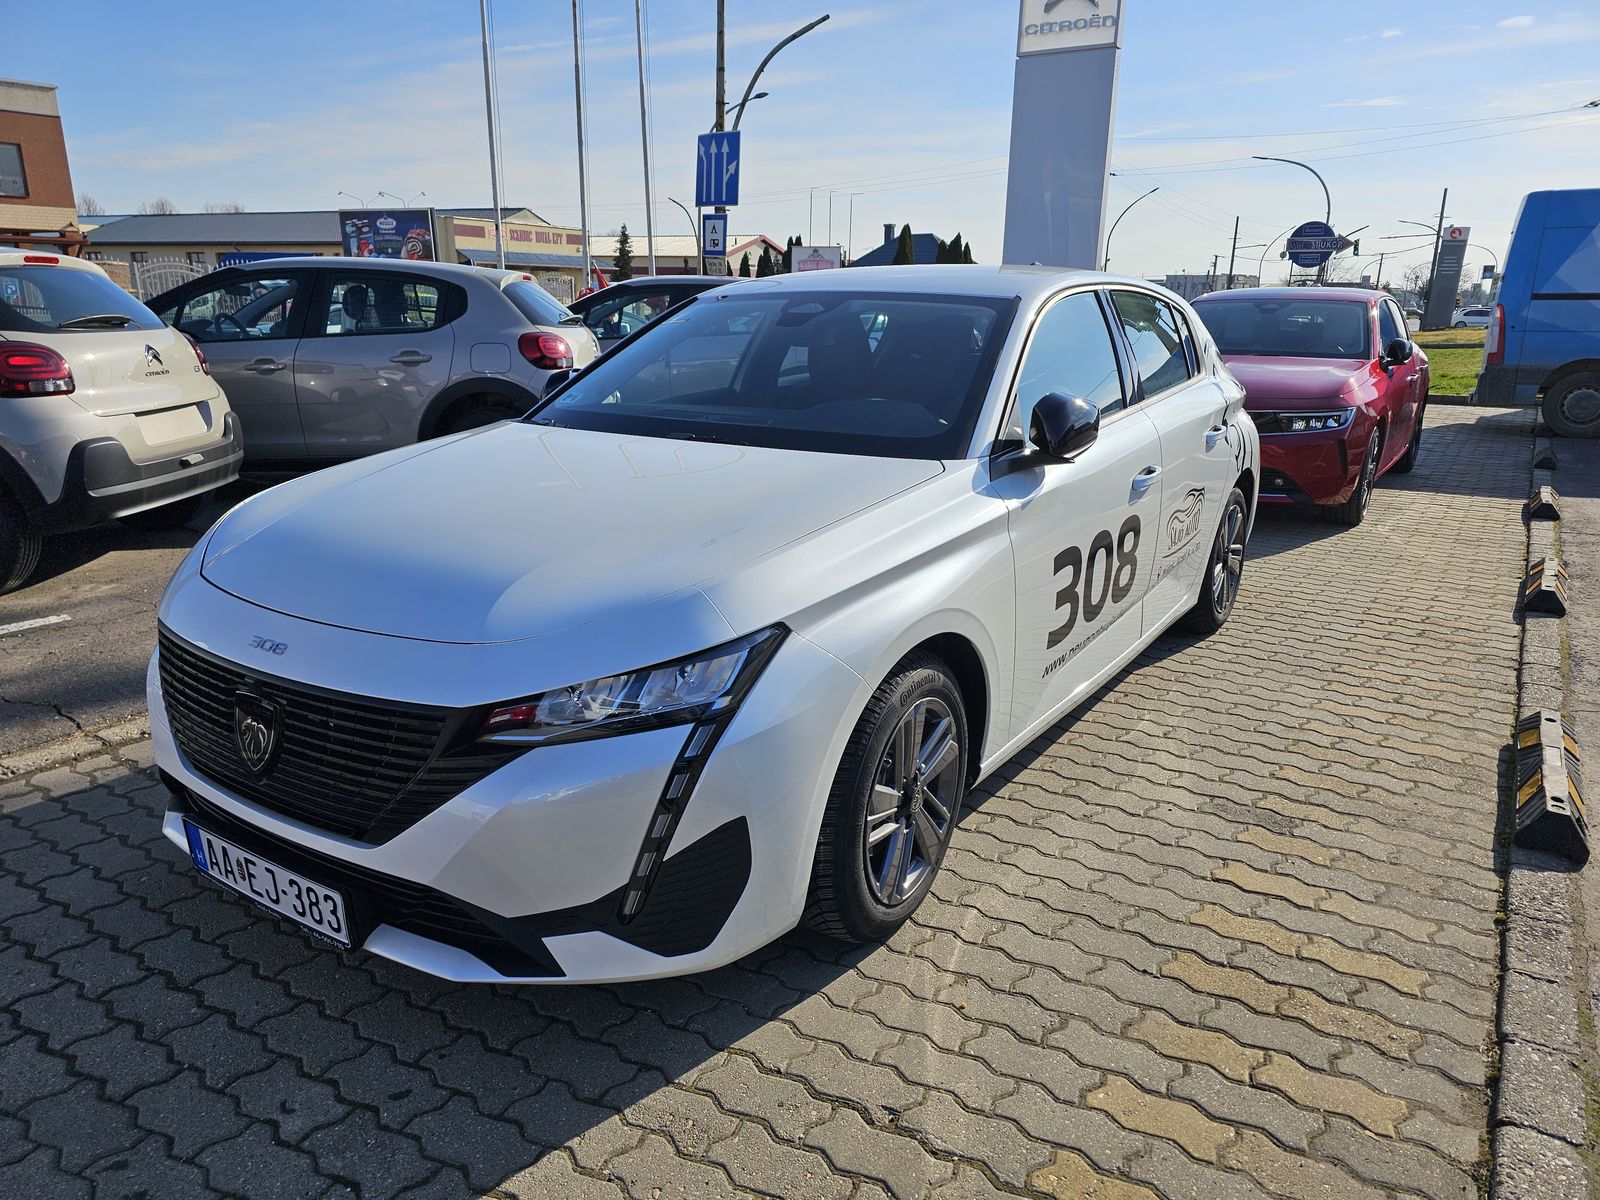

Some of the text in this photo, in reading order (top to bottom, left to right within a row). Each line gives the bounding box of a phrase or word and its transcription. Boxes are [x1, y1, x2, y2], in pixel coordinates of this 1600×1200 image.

[1024, 13, 1117, 35] CITROËN
[1046, 514, 1141, 650] 308
[248, 635, 288, 656] 308
[900, 670, 936, 708] Continental
[206, 837, 239, 884] AA
[243, 856, 342, 934] EJ-383
